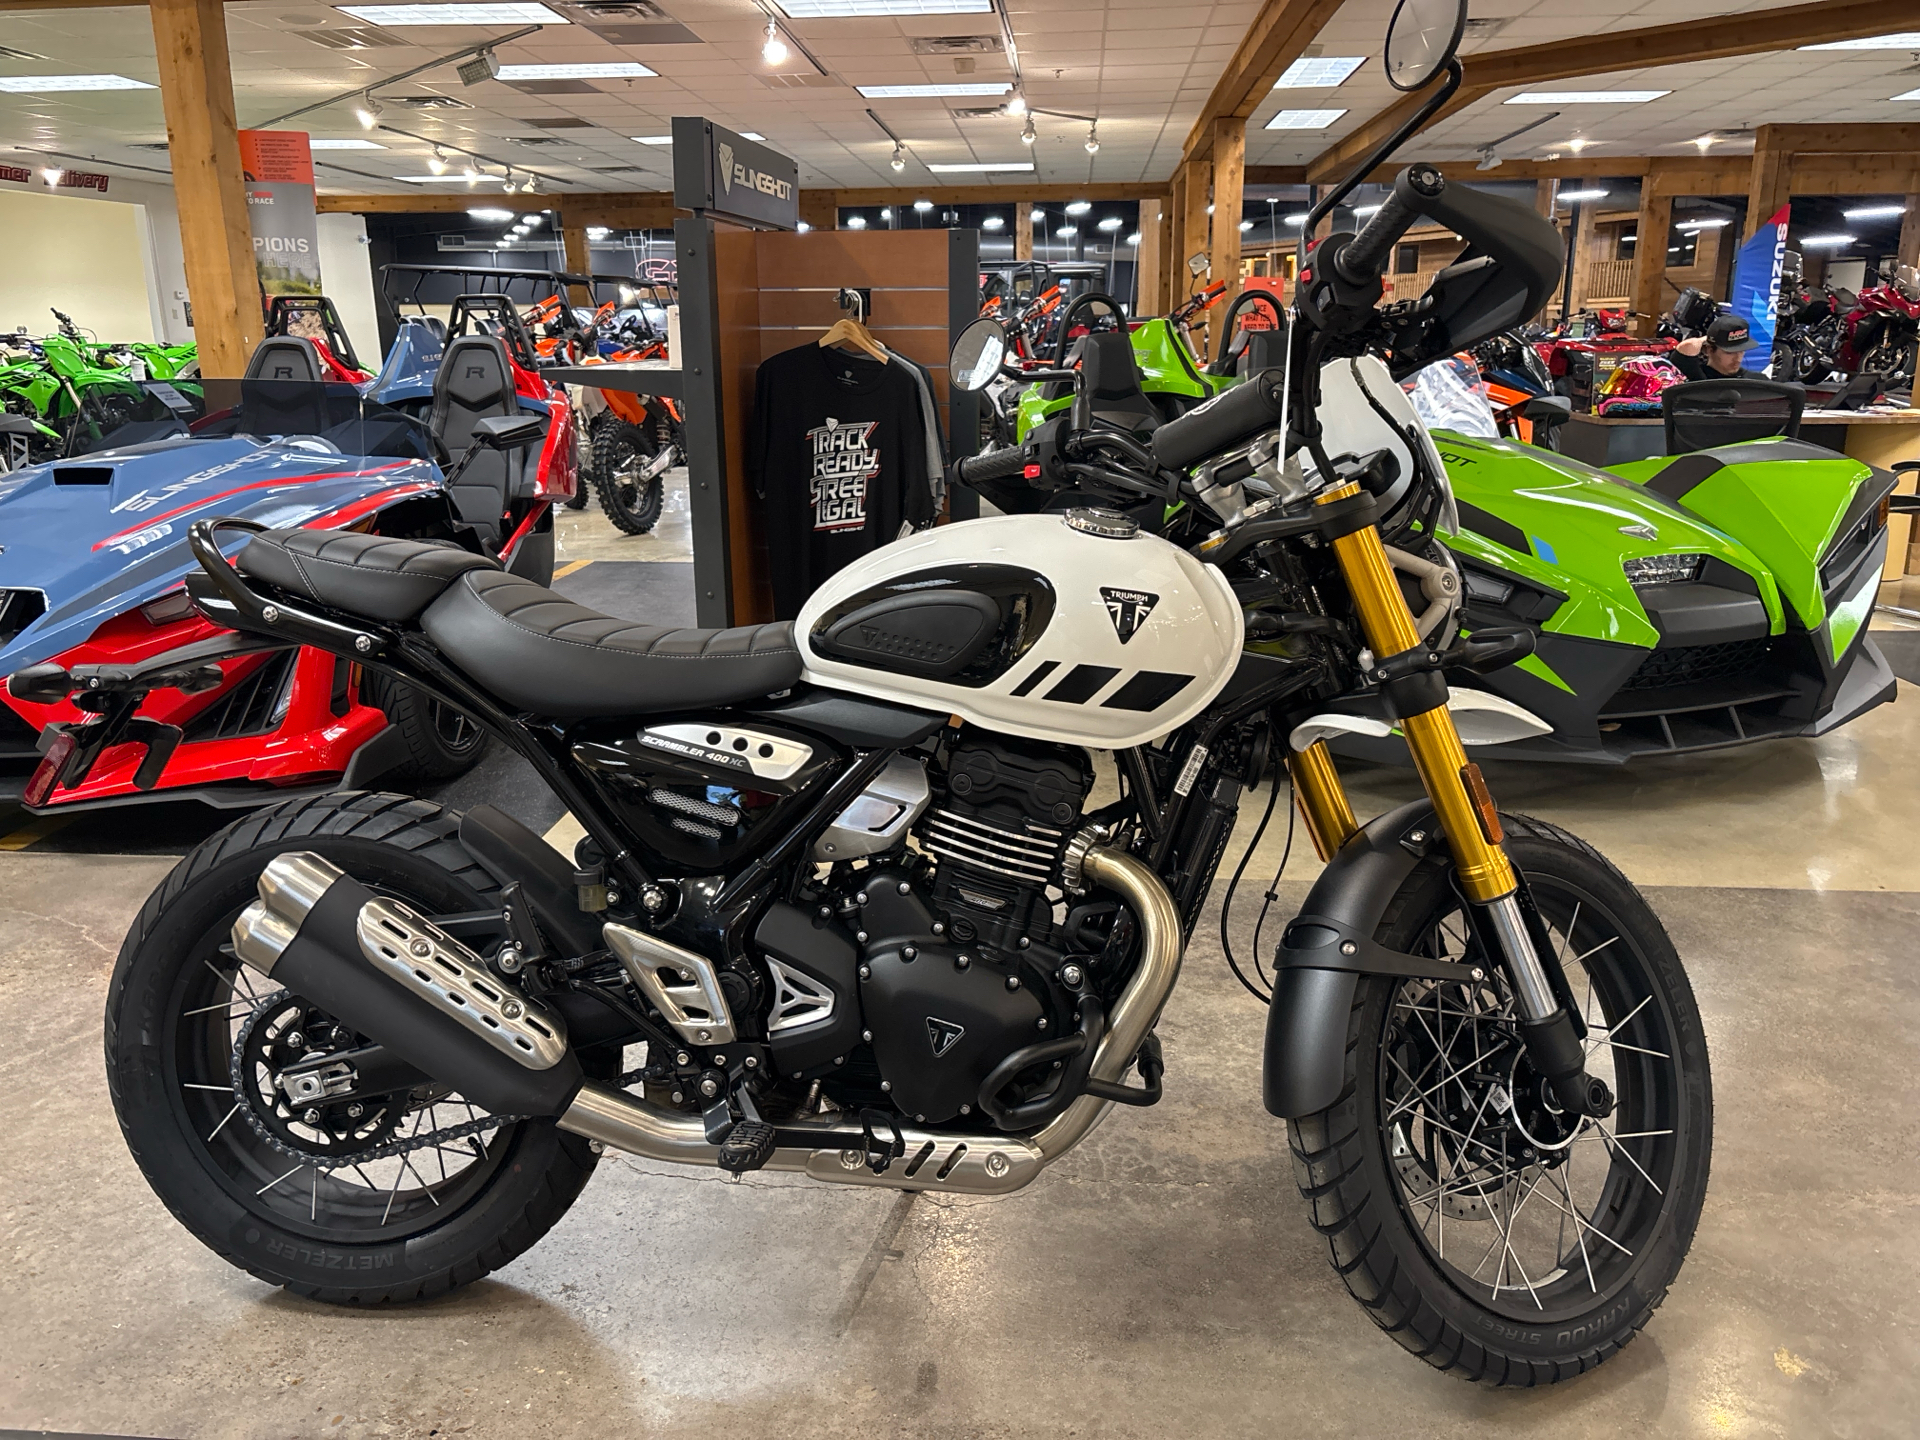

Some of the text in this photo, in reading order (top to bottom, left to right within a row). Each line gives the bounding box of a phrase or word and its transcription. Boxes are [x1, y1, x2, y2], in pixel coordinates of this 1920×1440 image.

[734, 163, 792, 201] SLINGSHOT
[1766, 222, 1788, 321] SUZUKI
[805, 422, 880, 455] TRACK
[124, 450, 282, 512] SLINGSHOT
[810, 469, 880, 506] STREET
[813, 497, 867, 530] LEGAL
[1110, 590, 1149, 602] TRIUMPH
[641, 735, 746, 768] SCRAMBLER 400 XC
[265, 1237, 395, 1270] METZELER
[1471, 1297, 1631, 1349] KAROO STREET
